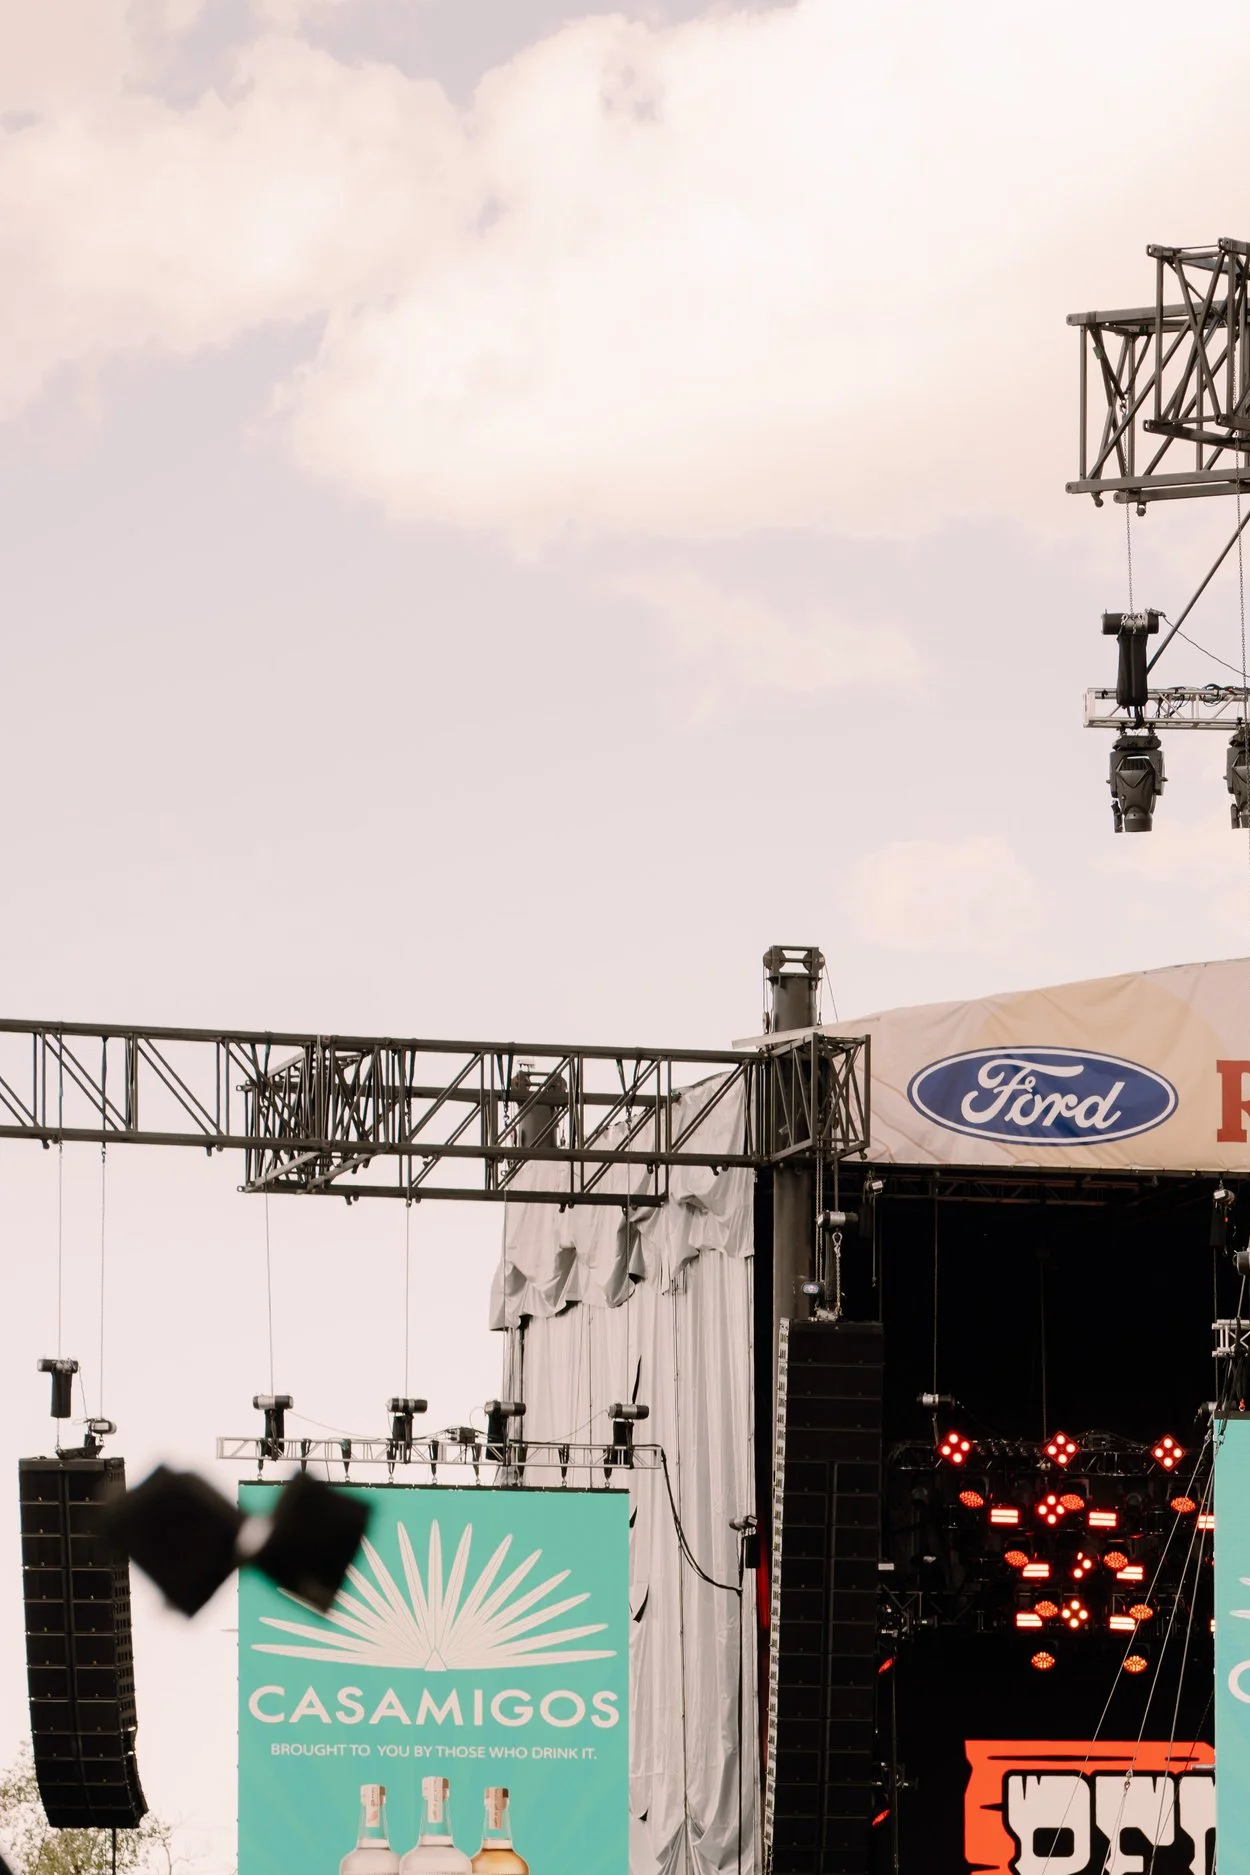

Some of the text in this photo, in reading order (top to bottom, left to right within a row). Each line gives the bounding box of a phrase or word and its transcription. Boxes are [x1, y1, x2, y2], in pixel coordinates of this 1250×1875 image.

[960, 1058, 1126, 1130] Ford
[248, 1685, 620, 1729] CASAMIGOS
[270, 1743, 597, 1760] BROUGHT TO YOU BY THOSE WHO DRINK IT.
